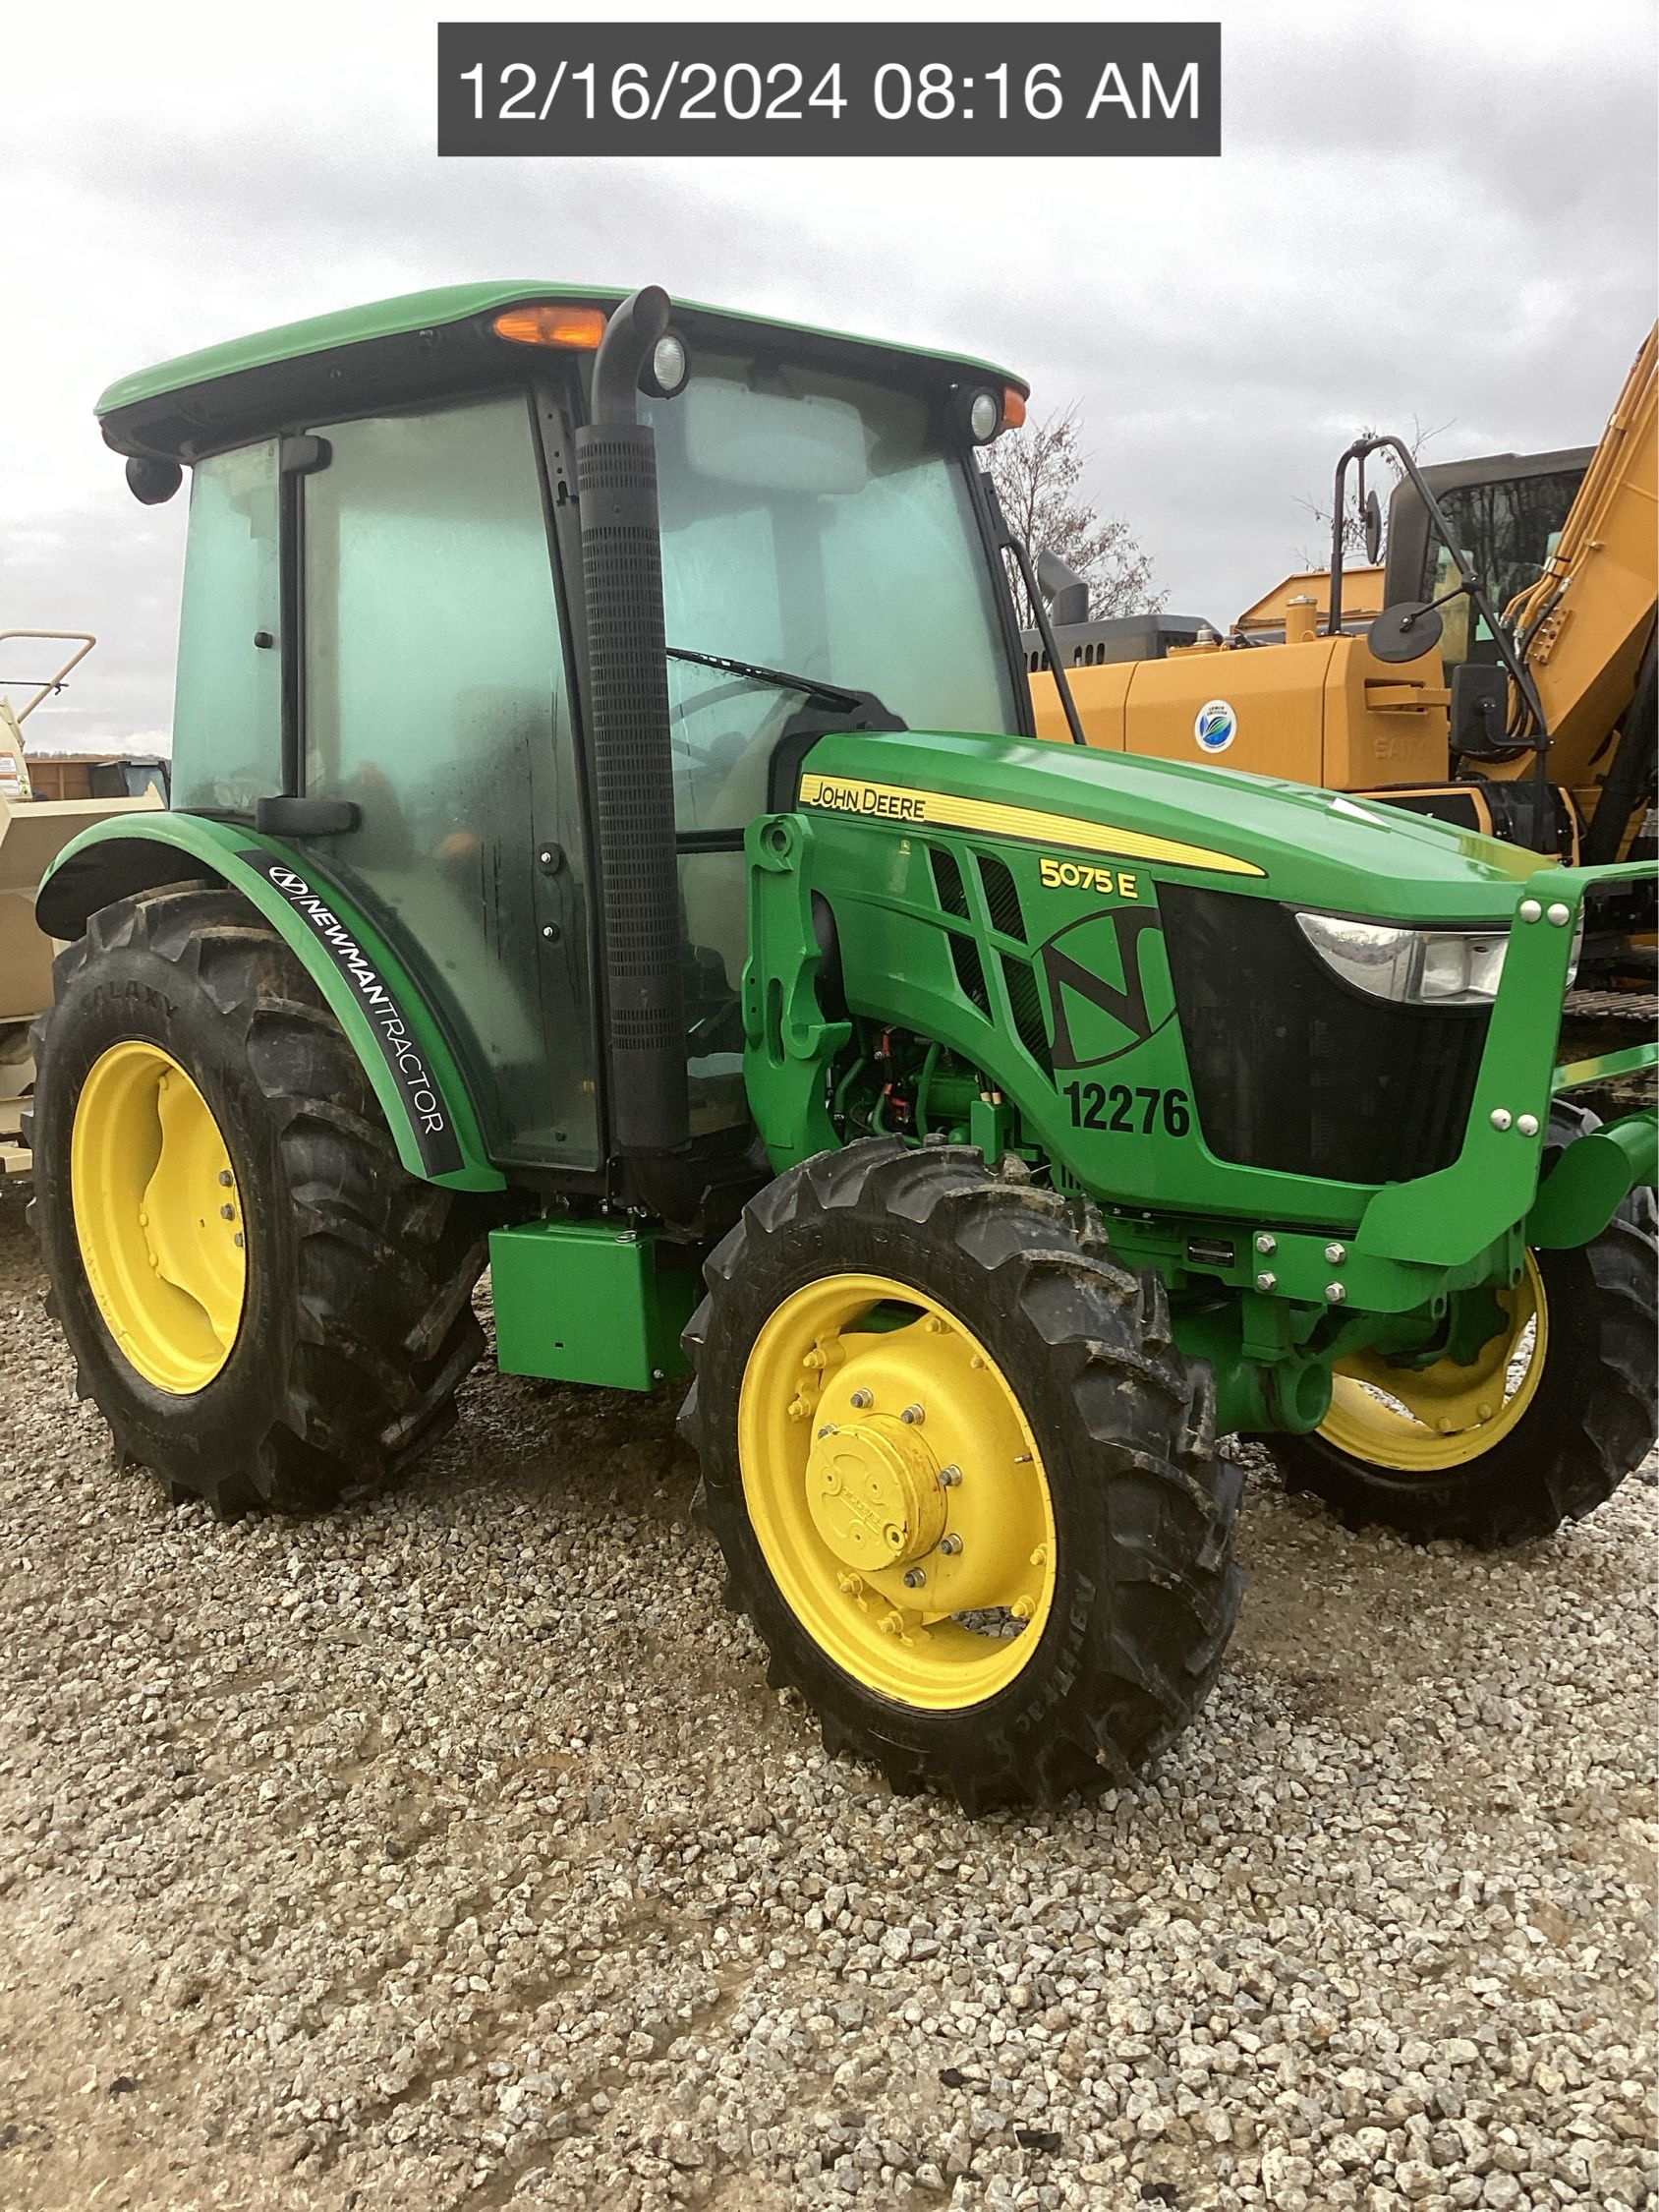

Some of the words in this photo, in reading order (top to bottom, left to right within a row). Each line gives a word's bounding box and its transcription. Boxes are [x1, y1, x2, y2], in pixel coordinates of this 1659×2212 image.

[813, 782, 860, 809] JOHN
[862, 787, 927, 819] DEERE
[1039, 858, 1115, 894] 5075
[1116, 871, 1140, 900] E
[1062, 1079, 1190, 1137] 12276
